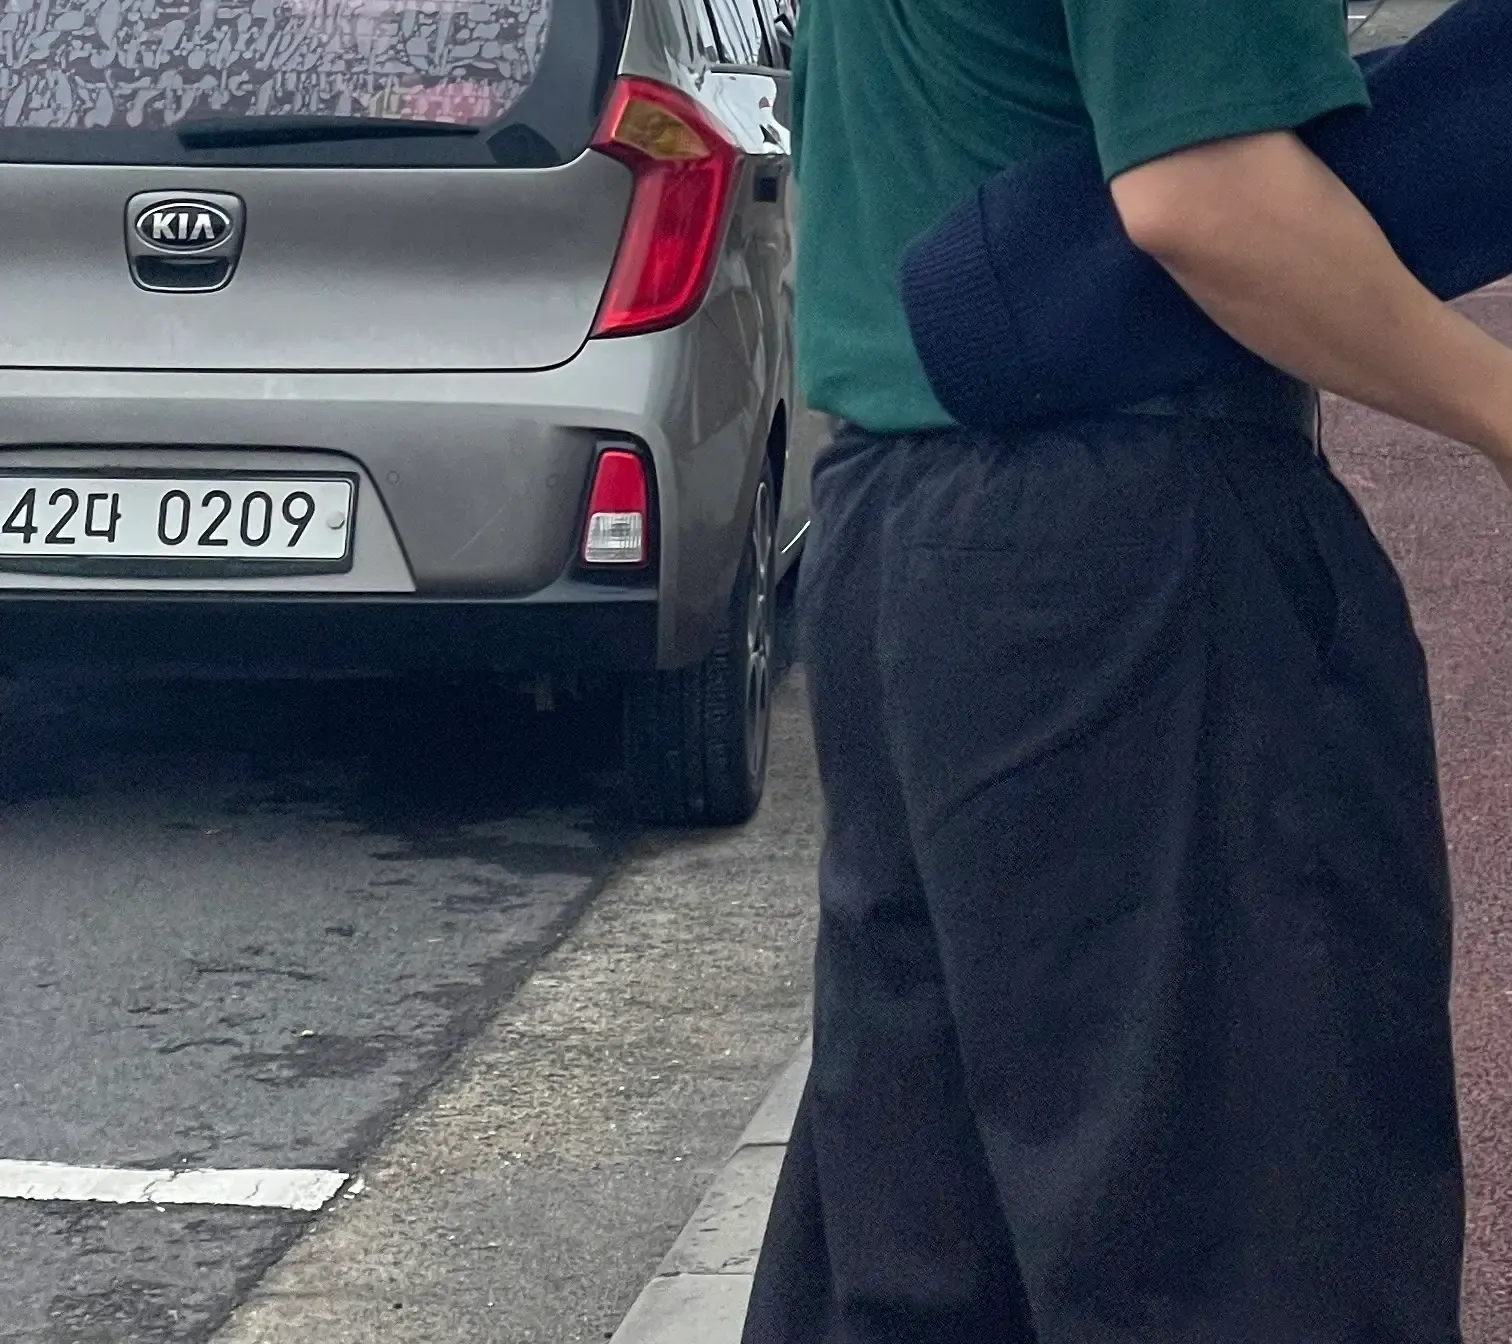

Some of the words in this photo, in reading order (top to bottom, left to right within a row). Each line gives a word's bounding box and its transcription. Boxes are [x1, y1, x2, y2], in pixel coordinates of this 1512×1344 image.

[152, 212, 215, 240] KIA
[1, 487, 122, 545] 42다
[157, 489, 316, 547] 0209
